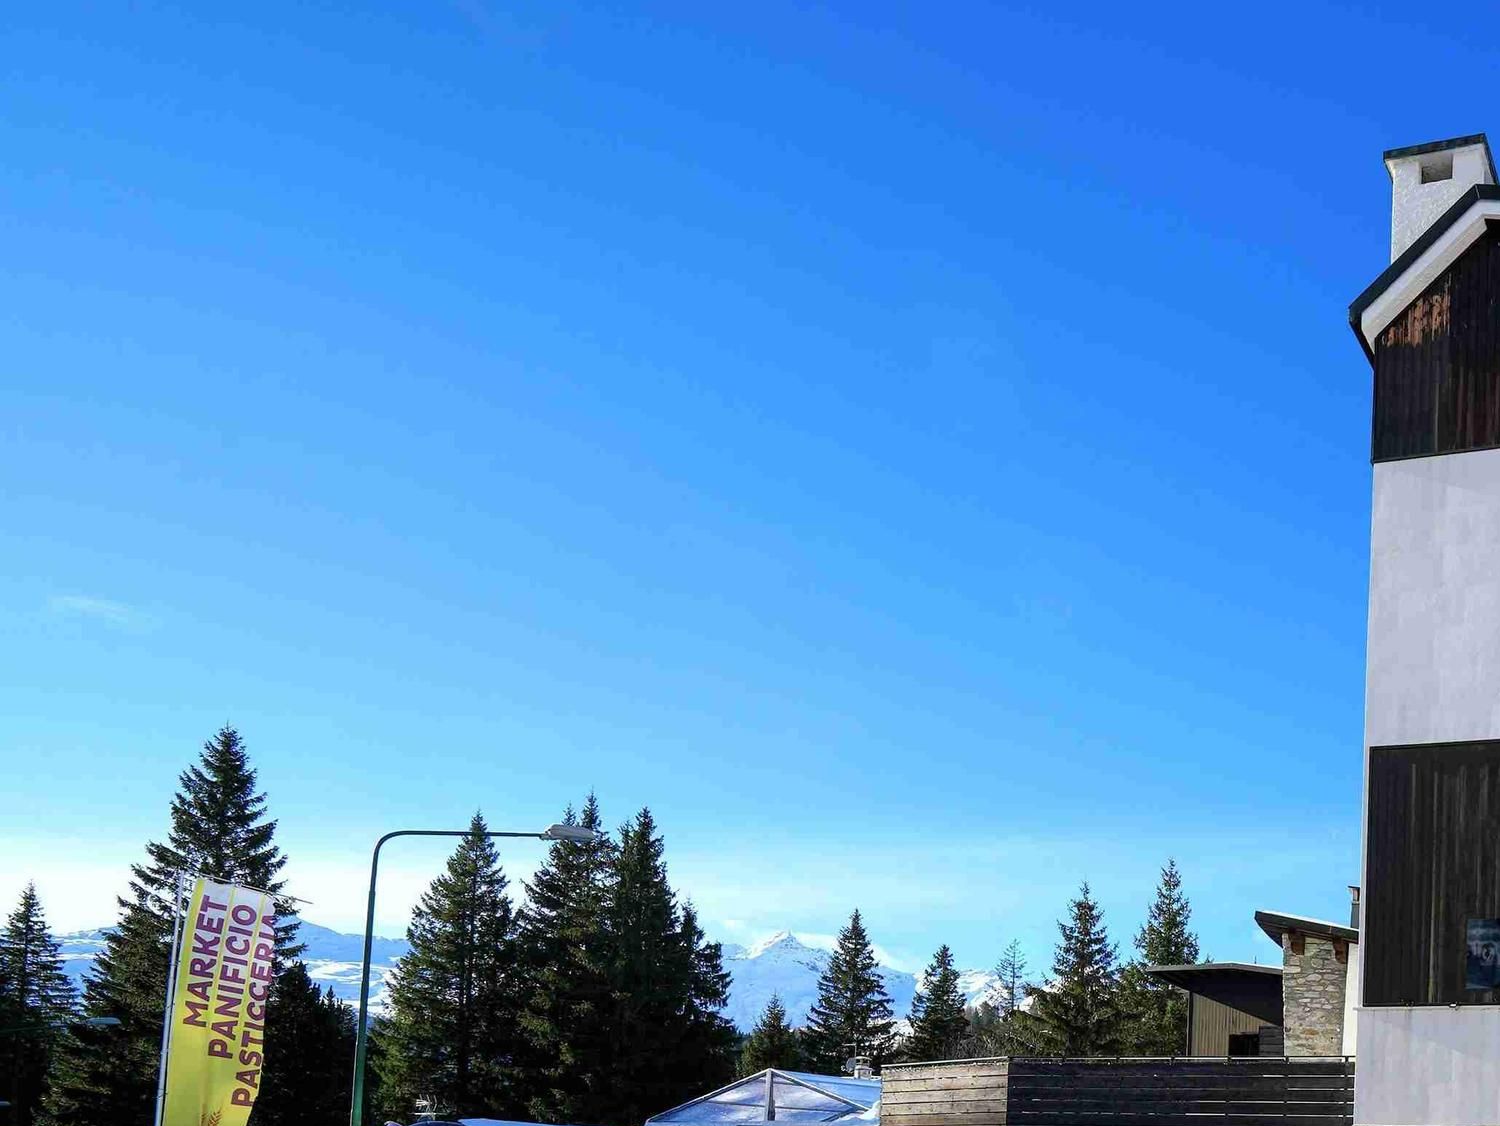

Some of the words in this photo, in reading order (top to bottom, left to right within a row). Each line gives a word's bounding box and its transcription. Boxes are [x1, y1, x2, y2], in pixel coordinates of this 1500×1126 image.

[183, 895, 227, 1027] MARKET
[208, 904, 257, 1059] PANIFICIO
[231, 914, 275, 1107] PASTICCERIA
